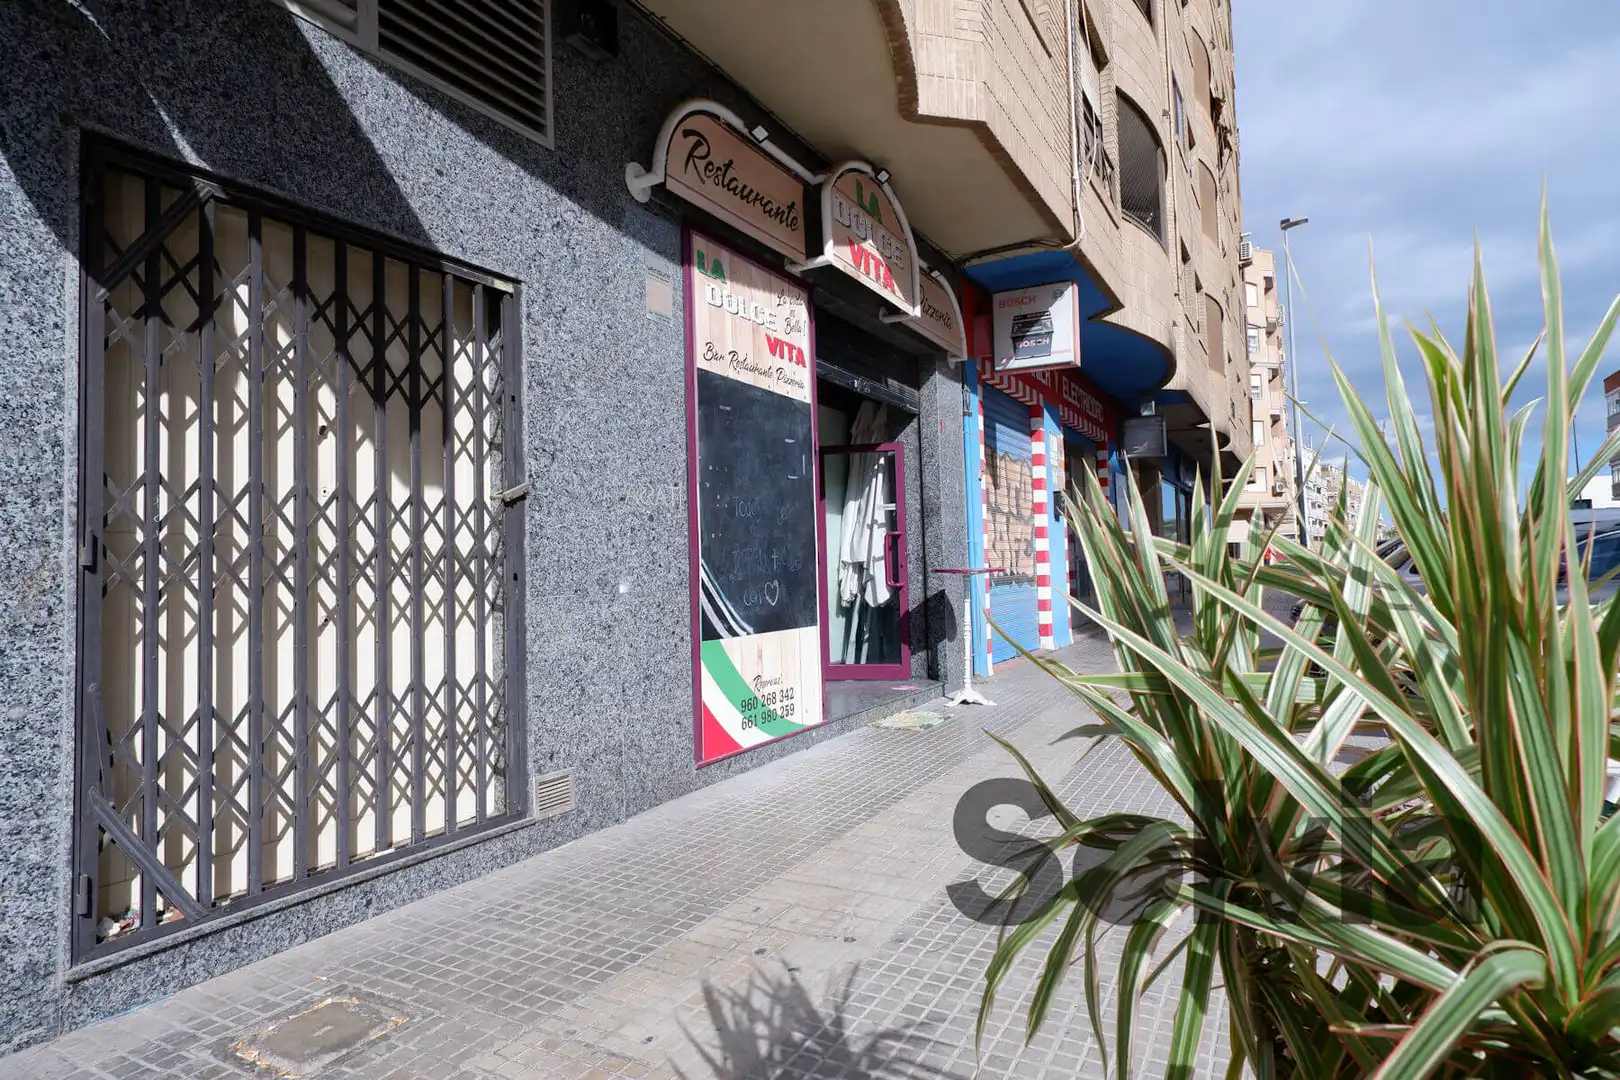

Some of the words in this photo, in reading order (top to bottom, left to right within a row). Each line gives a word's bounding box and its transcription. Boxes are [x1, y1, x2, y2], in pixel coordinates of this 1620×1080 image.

[682, 129, 800, 231] Restaurante
[856, 178, 882, 224] LA
[834, 195, 904, 270] DOLCE
[696, 249, 727, 284] LA
[848, 236, 895, 294] VITA
[706, 281, 778, 332] DOLCE
[998, 295, 1037, 308] BOSCH
[703, 341, 725, 361] Bar
[728, 350, 774, 380] Restaurante
[775, 367, 805, 390] Pizzeria
[765, 333, 807, 368] VITA
[741, 696, 758, 713] 960
[761, 691, 777, 707] 268
[779, 687, 795, 702] 342
[741, 713, 758, 731] 661
[761, 708, 777, 725] 980
[779, 703, 795, 719] 259
